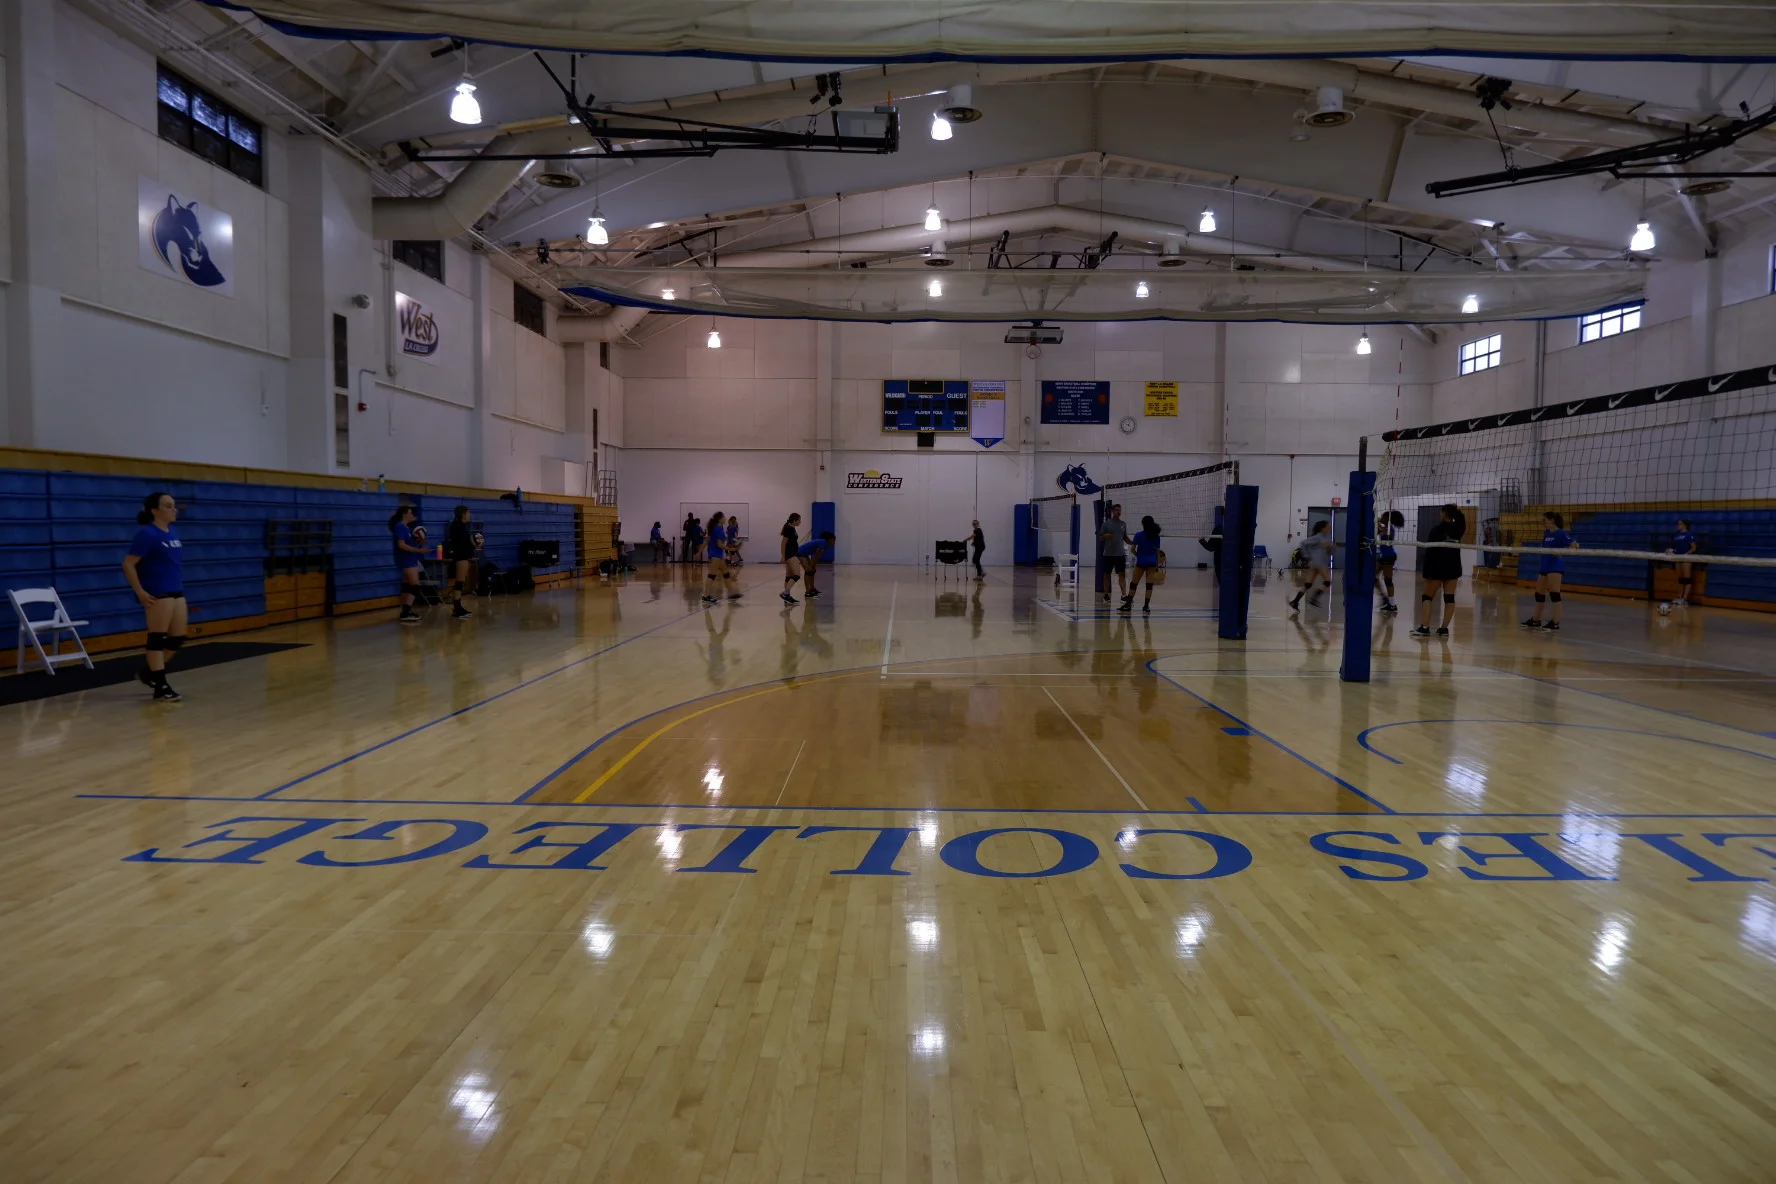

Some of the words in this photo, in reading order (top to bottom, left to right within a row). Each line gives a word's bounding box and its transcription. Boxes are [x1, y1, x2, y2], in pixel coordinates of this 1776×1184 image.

[400, 300, 434, 341] West
[881, 474, 902, 484] STATE
[121, 816, 1253, 879] COLLEGE
